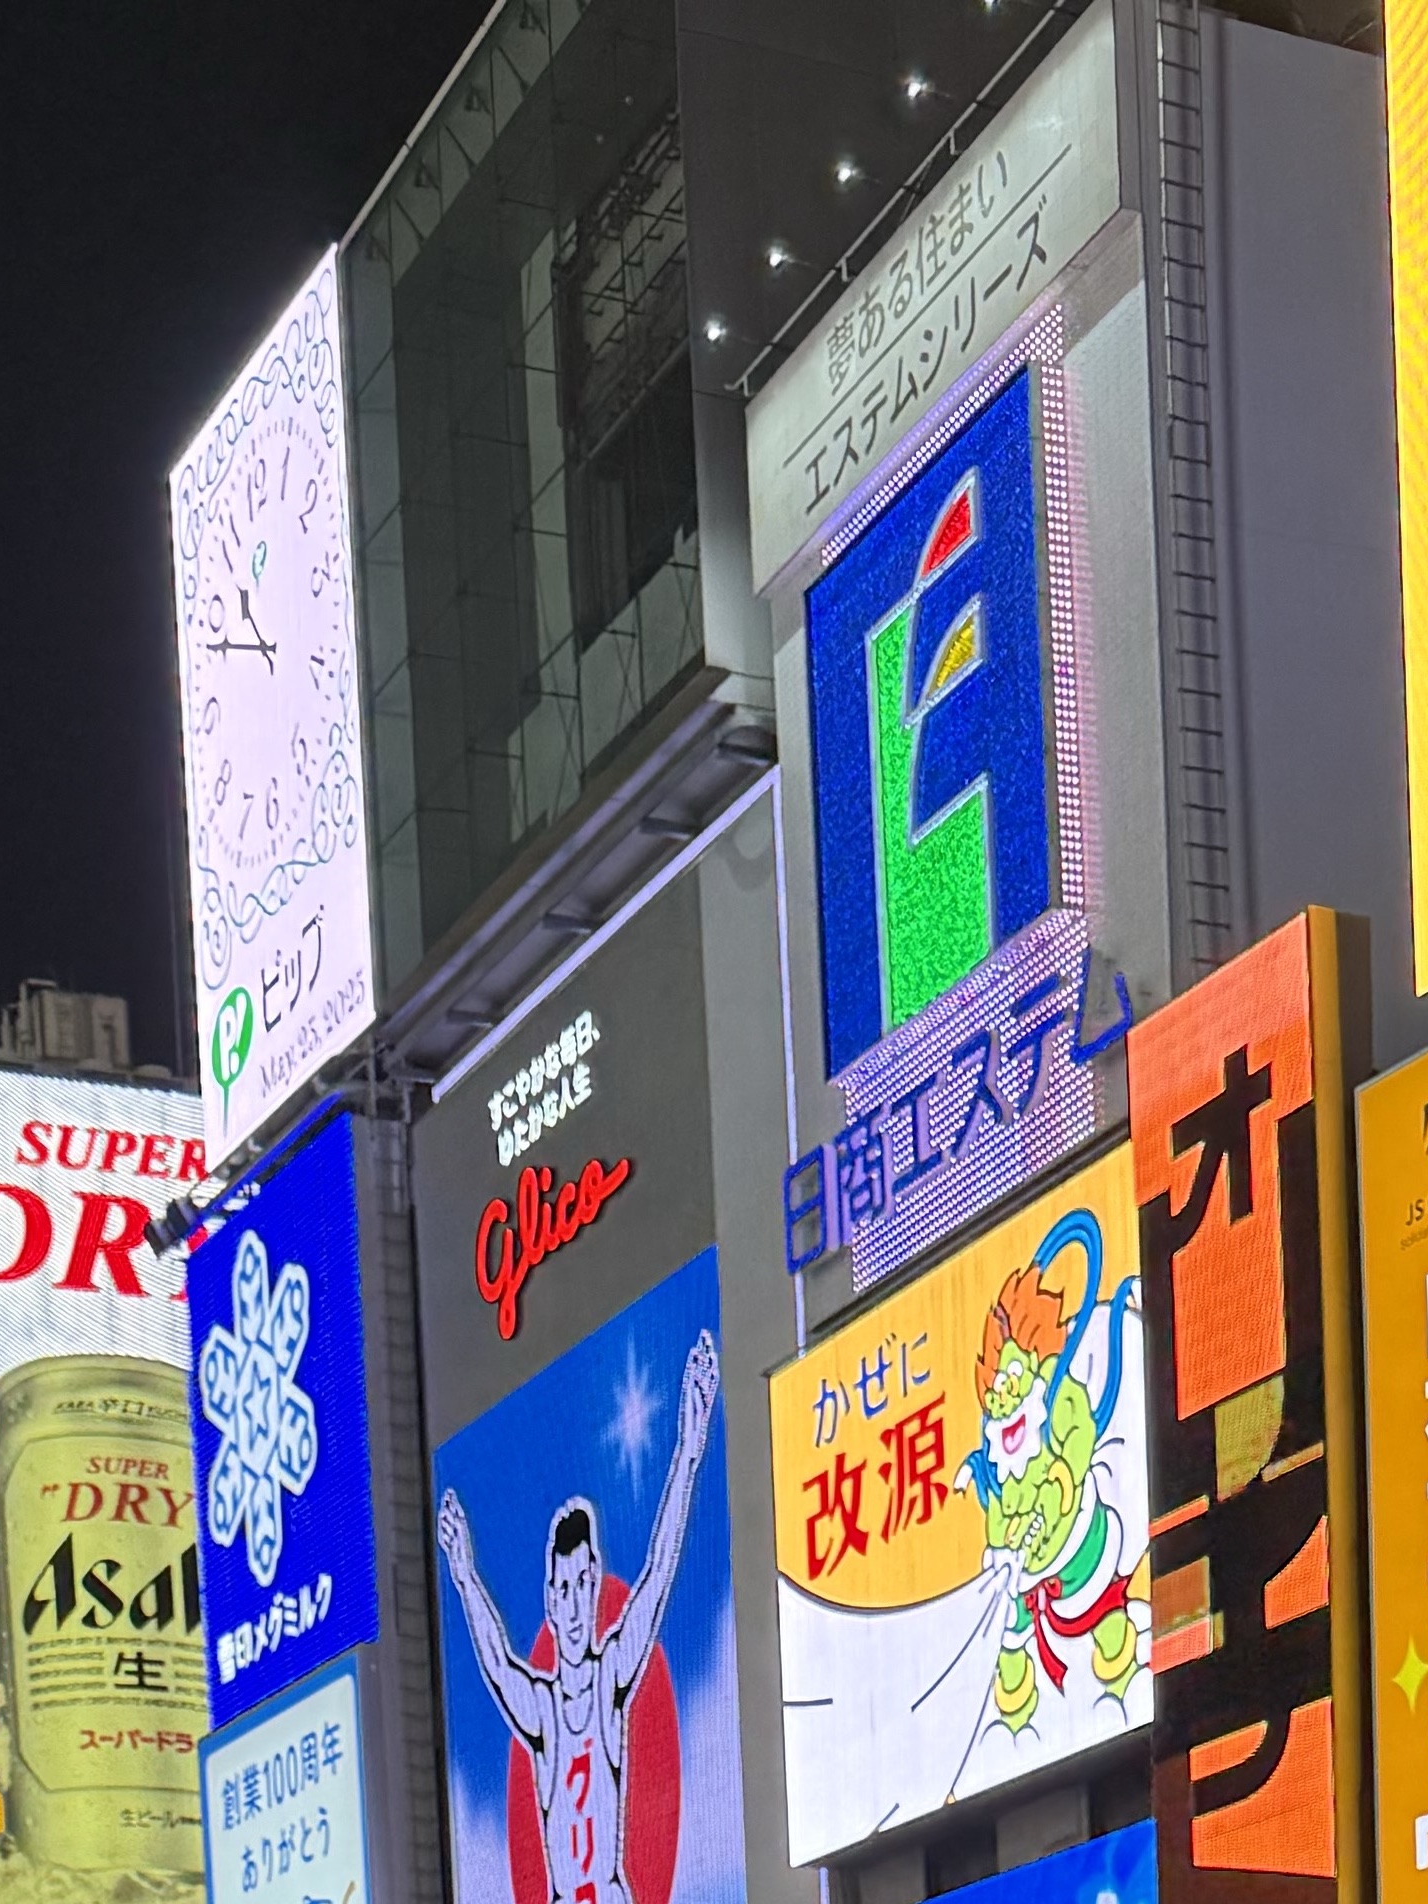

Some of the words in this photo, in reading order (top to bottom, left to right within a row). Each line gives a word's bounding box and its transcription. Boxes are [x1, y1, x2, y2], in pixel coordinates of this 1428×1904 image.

[827, 150, 1008, 397] 夢ある住まい
[804, 193, 1048, 516] エステムシリーズ
[261, 904, 325, 1034] ピップ
[783, 948, 1133, 1274] 日商エステム
[475, 1158, 630, 1341] Glico
[1405, 1199, 1425, 1227] JS
[812, 1330, 933, 1449] かぜに
[85, 1456, 170, 1481] SUPER
[801, 1391, 951, 1581] 改源
[113, 1651, 169, 1692] 生
[241, 1805, 331, 1893] ありがとう
